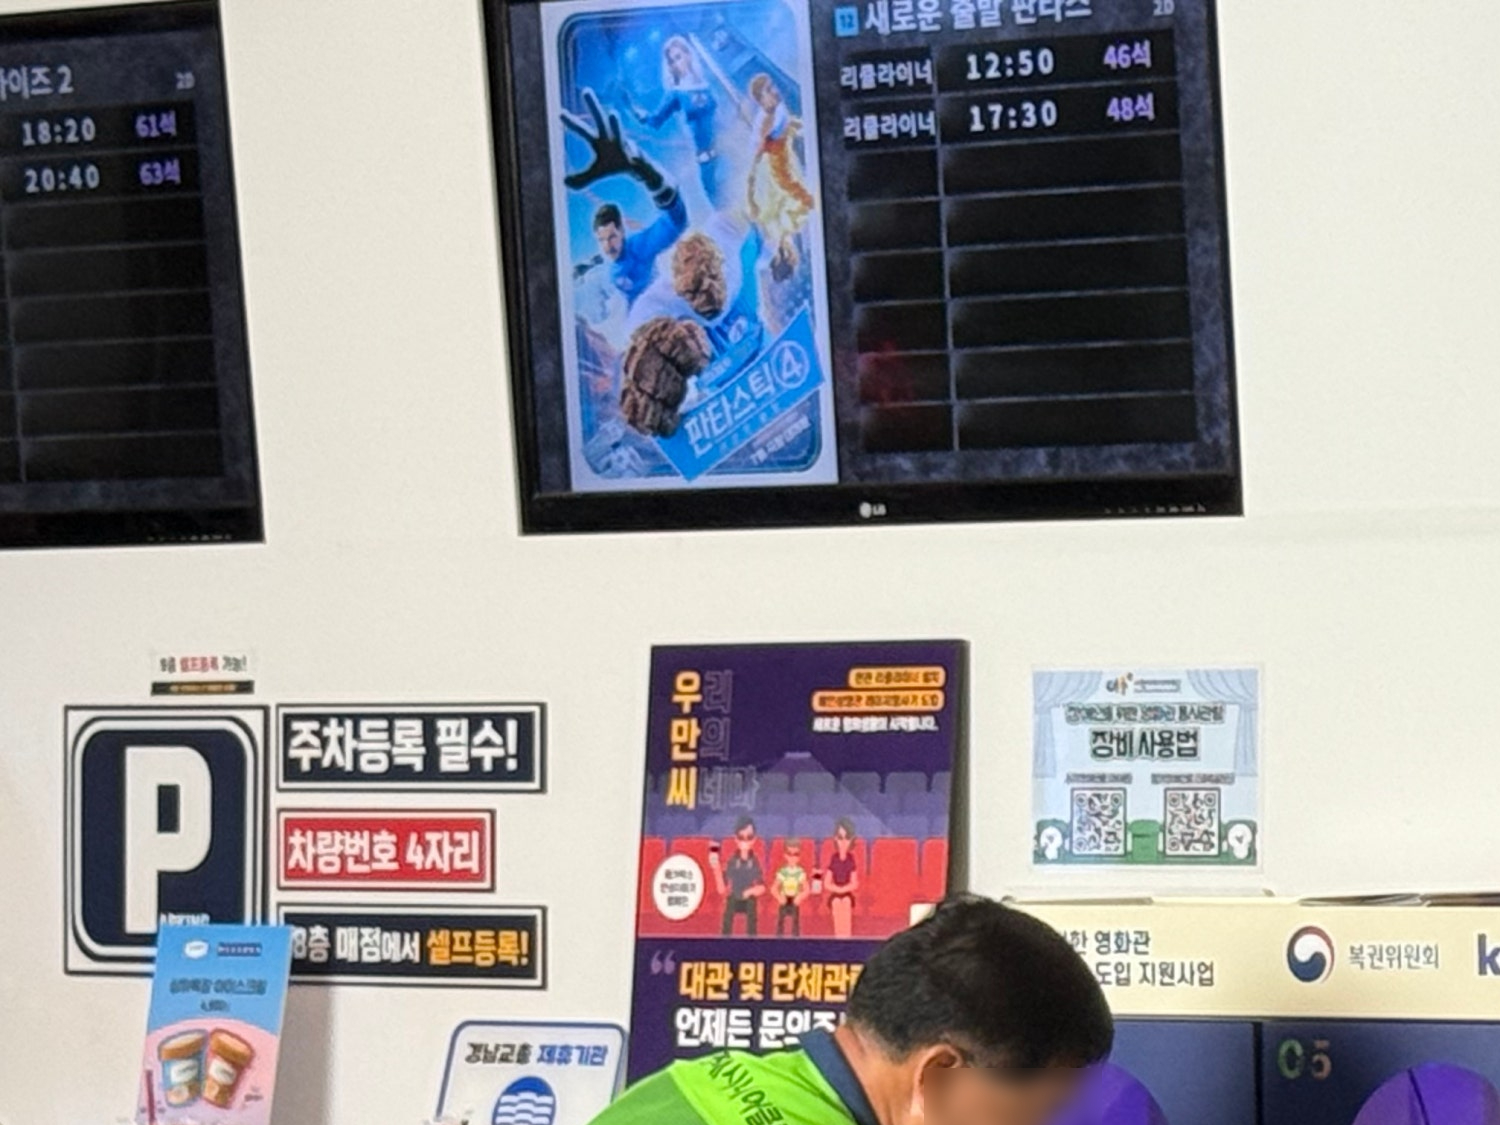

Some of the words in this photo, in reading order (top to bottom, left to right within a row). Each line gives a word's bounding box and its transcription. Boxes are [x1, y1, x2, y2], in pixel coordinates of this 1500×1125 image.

[866, 1, 944, 35] 새로운
[966, 47, 1056, 81] 12:50
[1103, 39, 1152, 70] 46석
[58, 66, 74, 95] 2
[22, 118, 96, 146] 18:20
[135, 111, 177, 138] 61석
[969, 100, 1058, 132] 17:30
[1107, 93, 1156, 123] 48석
[25, 165, 100, 194] 20:40
[139, 158, 182, 187] 63석
[288, 718, 427, 773] 주차등록
[434, 717, 518, 773] 필수!
[1091, 729, 1134, 759] 장비
[1138, 729, 1200, 759] 사용법
[124, 745, 213, 934] P
[288, 830, 400, 873] 차량번호
[405, 830, 481, 875] 4자리
[335, 926, 421, 964] 매점에서
[426, 926, 531, 966] 셀프등록!
[1063, 929, 1088, 955] 한
[1094, 929, 1151, 955] 영화관
[1348, 943, 1441, 972] 복권위원회
[679, 961, 733, 1001] 대관
[738, 961, 765, 1001] 및
[1095, 961, 1132, 987] 도입
[1138, 960, 1215, 987] 지원사업
[675, 1006, 753, 1048] 언제든
[536, 1040, 609, 1067] 제휴기관
[1277, 1039, 1333, 1081] 05
